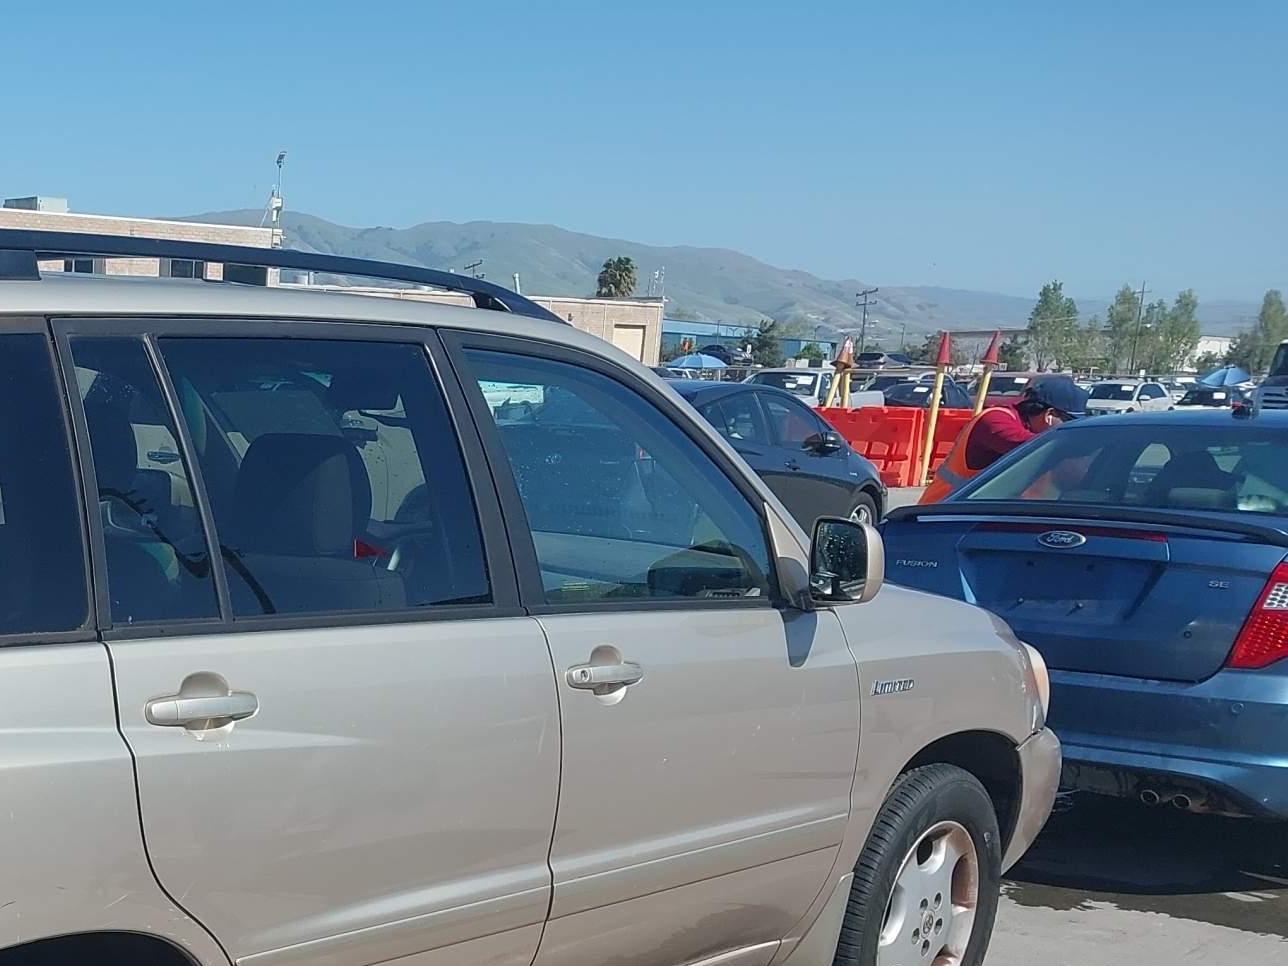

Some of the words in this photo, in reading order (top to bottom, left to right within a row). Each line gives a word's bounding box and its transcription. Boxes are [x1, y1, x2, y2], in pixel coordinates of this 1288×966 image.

[1046, 532, 1075, 544] Ford
[895, 559, 938, 568] FUSION
[1207, 580, 1230, 589] SE
